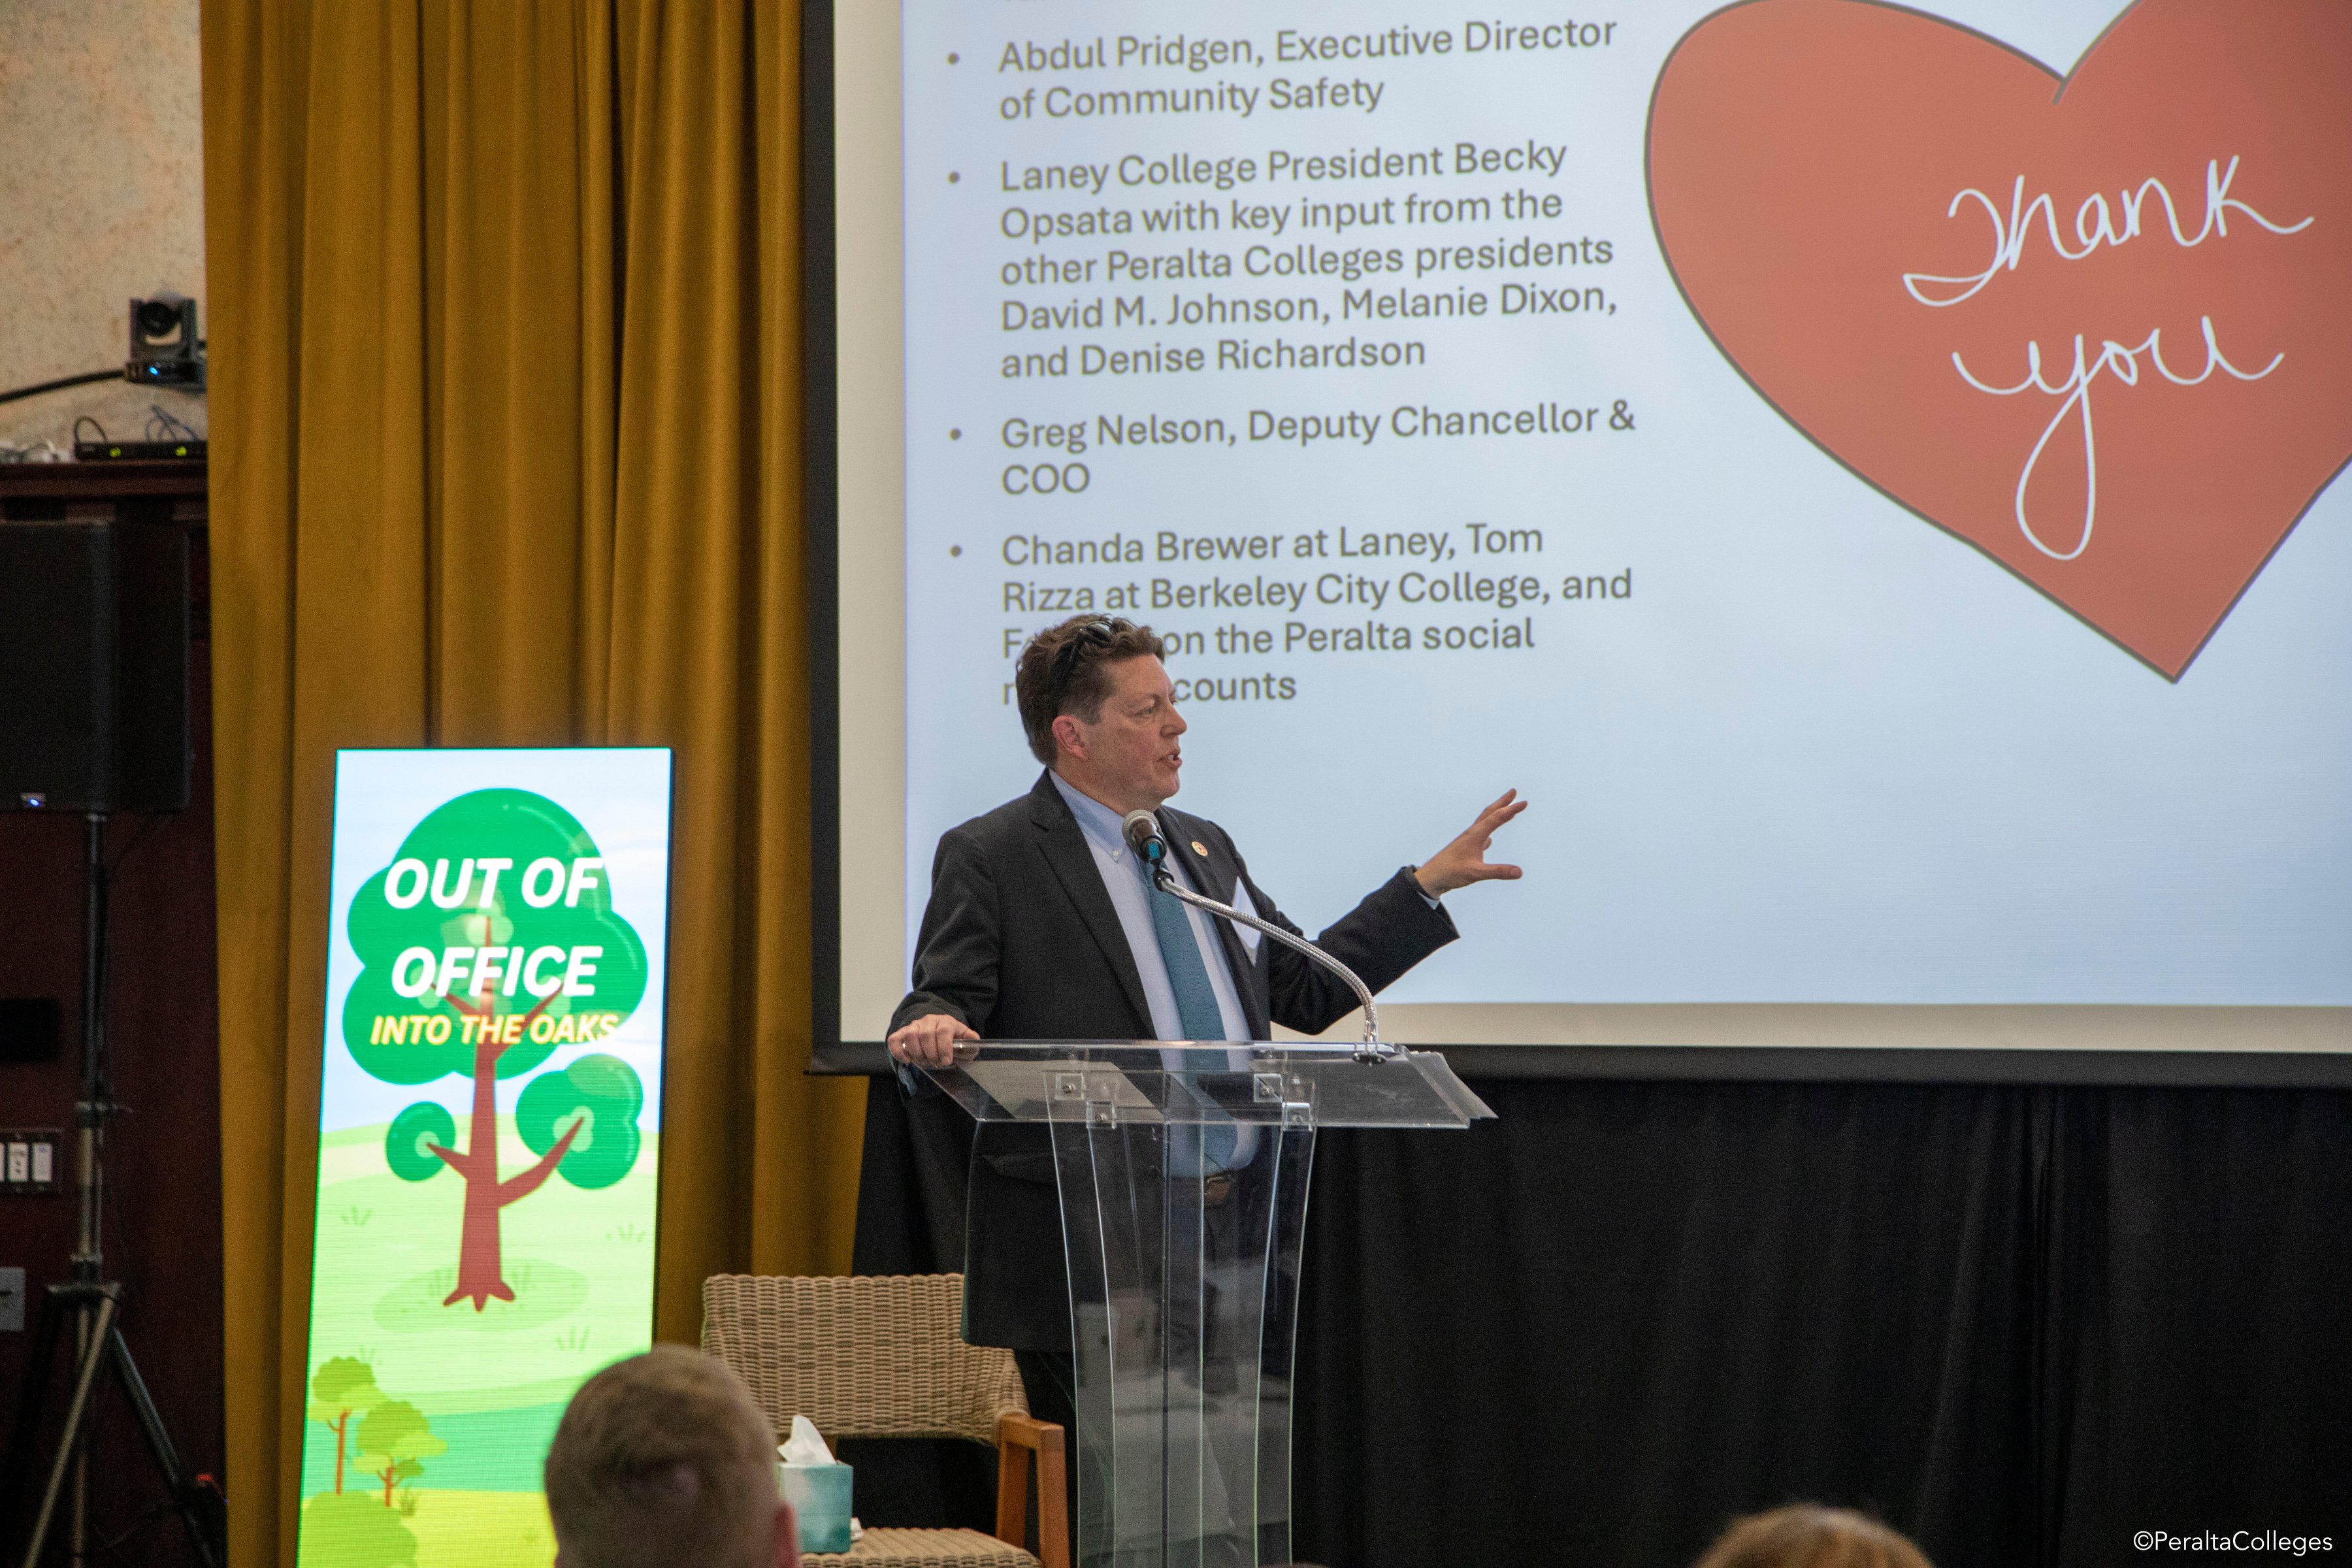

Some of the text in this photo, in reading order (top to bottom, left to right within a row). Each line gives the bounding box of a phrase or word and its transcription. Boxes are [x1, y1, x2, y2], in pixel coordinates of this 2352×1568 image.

[998, 19, 1618, 73] Abdul Pridgen, Executive Director
[1000, 76, 1384, 120] of Community Safety
[1002, 139, 1567, 195] Laney College President Becky
[1000, 188, 1563, 245] Opsata with key input from the
[1001, 235, 1614, 286] other Peralta Colleges presidents
[1002, 282, 1617, 331] David M. Johnson, Melanie Dixon,
[1002, 336, 1426, 379] and Denise Richardson
[1002, 399, 1636, 455] Greg Nelson, Deputy Chancellor &
[1952, 316, 2284, 561] you
[1002, 462, 1090, 495] COO
[1002, 523, 1543, 566] Chanda Brewer at Laney, Tom
[1004, 567, 1632, 613] Rizza at Berkeley City College, and
[1164, 616, 1535, 655] on the Peralta social
[1176, 673, 1296, 701] counts
[384, 857, 604, 909] OUT OF
[392, 946, 603, 998] OFFICE
[370, 1014, 619, 1045] INTO THE OAKS
